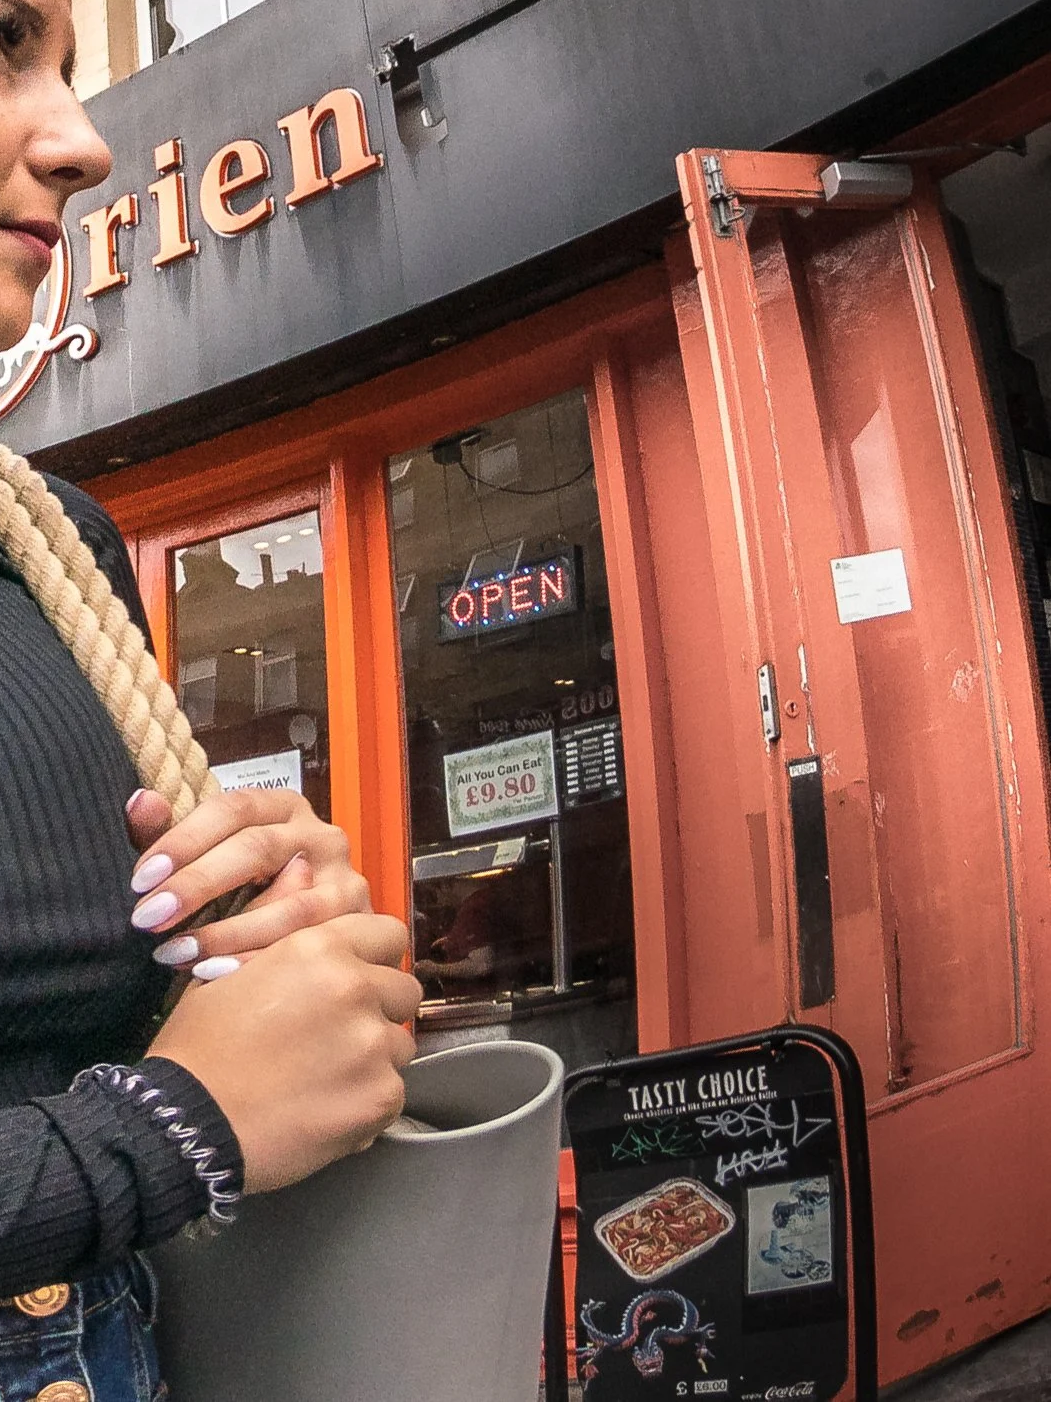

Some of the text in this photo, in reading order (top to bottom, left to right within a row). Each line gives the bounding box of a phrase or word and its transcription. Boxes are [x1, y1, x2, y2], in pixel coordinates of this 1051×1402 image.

[450, 566, 564, 624] OPEN
[457, 756, 543, 786] All You Can Eat
[791, 762, 816, 777] PUSH
[466, 773, 536, 808] £9.80
[628, 1065, 769, 1111] TASTY CHOICE
[701, 1099, 717, 1110] from
[676, 1381, 688, 1396] £
